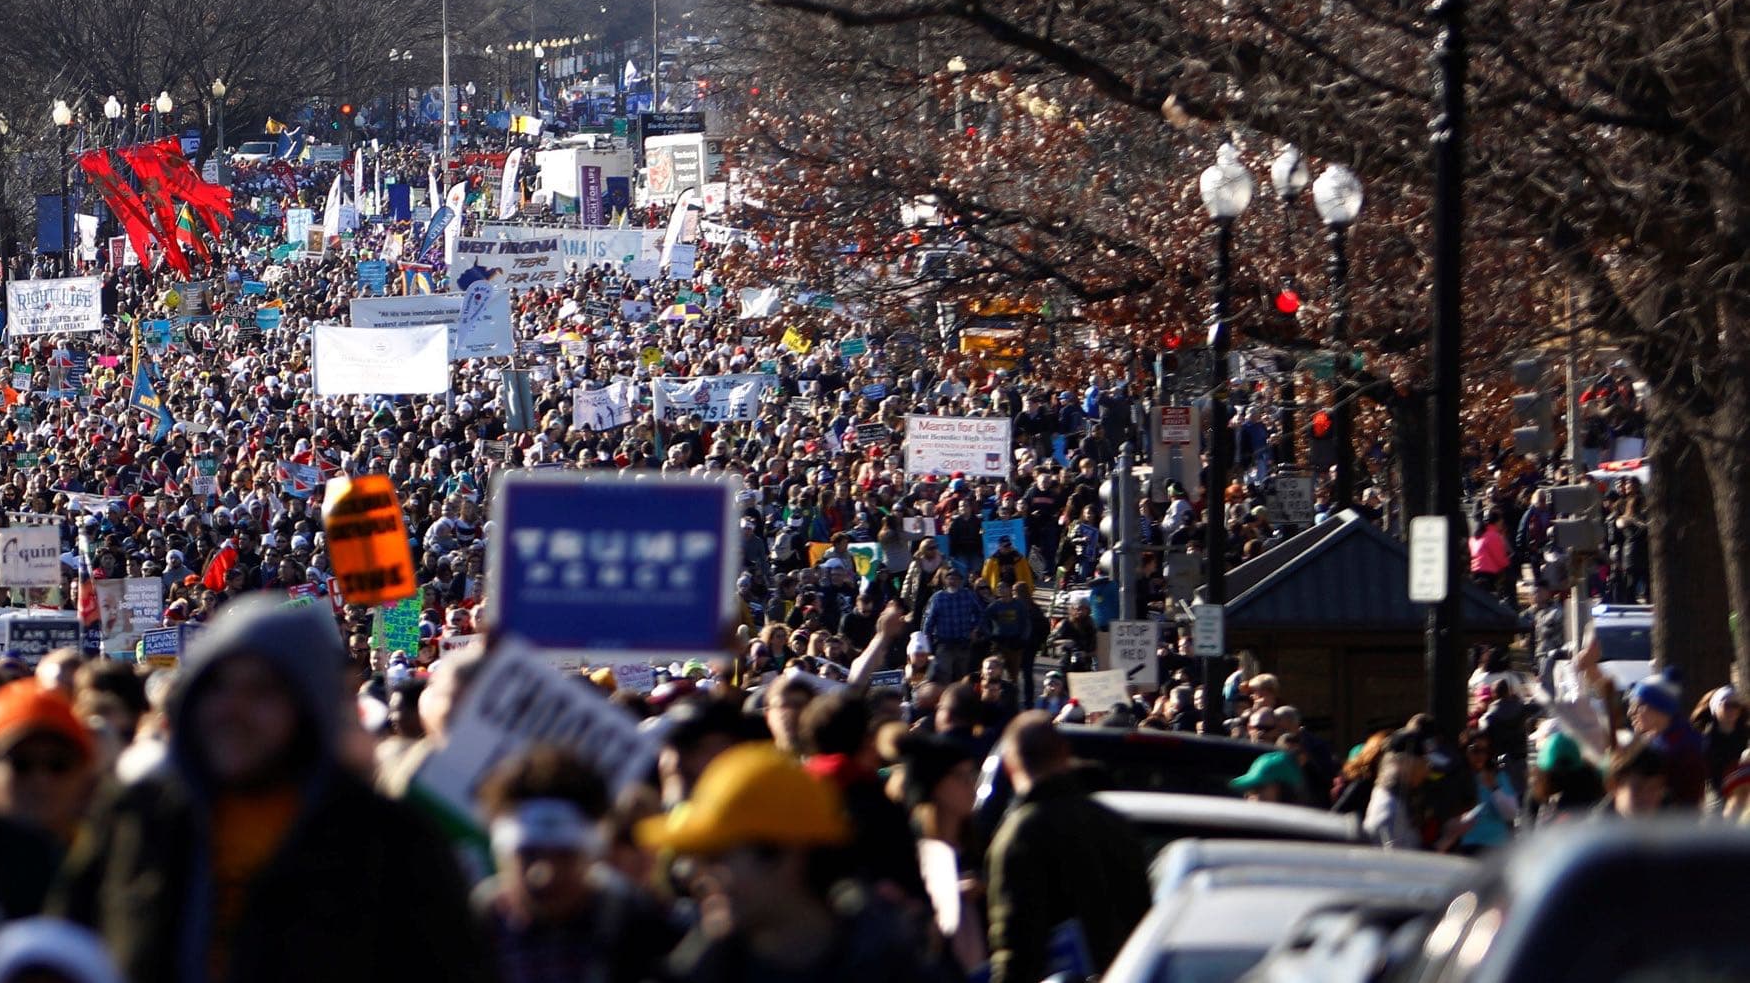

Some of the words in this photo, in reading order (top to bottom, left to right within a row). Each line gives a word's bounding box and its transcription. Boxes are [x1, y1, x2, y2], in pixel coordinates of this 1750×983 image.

[457, 240, 496, 254] WEST
[498, 238, 558, 254] VIRGINIA
[505, 273, 529, 284] FOR
[530, 270, 558, 282] LIFE
[17, 288, 55, 312] RIGHT
[62, 287, 93, 308] LIFE
[721, 403, 748, 418] LFE
[918, 420, 955, 431] March
[957, 421, 974, 432] for
[976, 421, 997, 433] Life
[3, 537, 56, 563] Aquin
[512, 528, 718, 565] TRUMP
[123, 593, 139, 602] can
[141, 591, 159, 601] feel
[144, 607, 158, 616] the
[23, 629, 44, 640] AM
[50, 628, 76, 640] THE
[1116, 624, 1149, 636] STOP
[1120, 648, 1146, 660] RED
